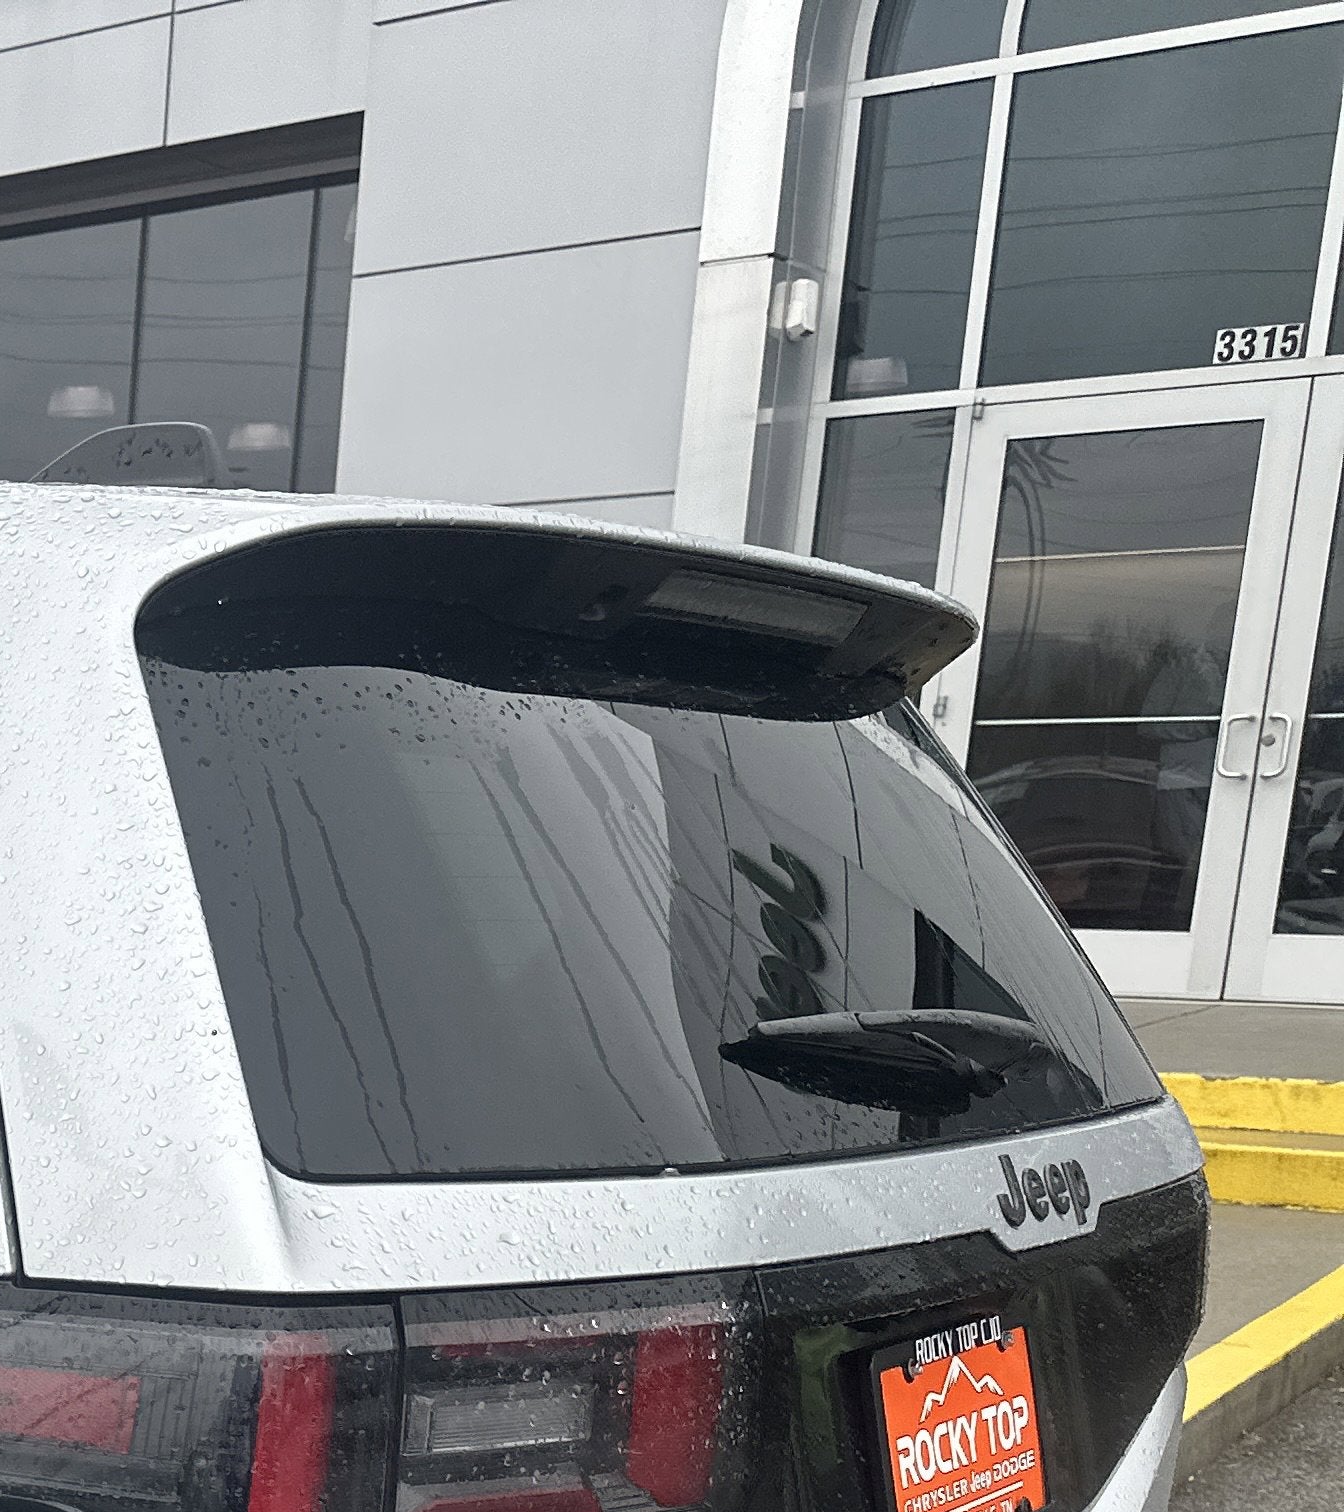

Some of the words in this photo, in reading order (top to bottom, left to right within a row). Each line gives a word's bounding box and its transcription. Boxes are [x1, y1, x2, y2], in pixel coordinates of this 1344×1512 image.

[1216, 324, 1300, 362] 3315
[996, 1153, 1092, 1230] Jeep
[915, 1330, 953, 1365] ROCKY
[955, 1322, 978, 1352] TOP
[896, 1411, 978, 1490] ROCKY
[980, 1394, 1030, 1456] TOP
[970, 1469, 993, 1494] Jeep
[992, 1449, 1036, 1483] DODGE
